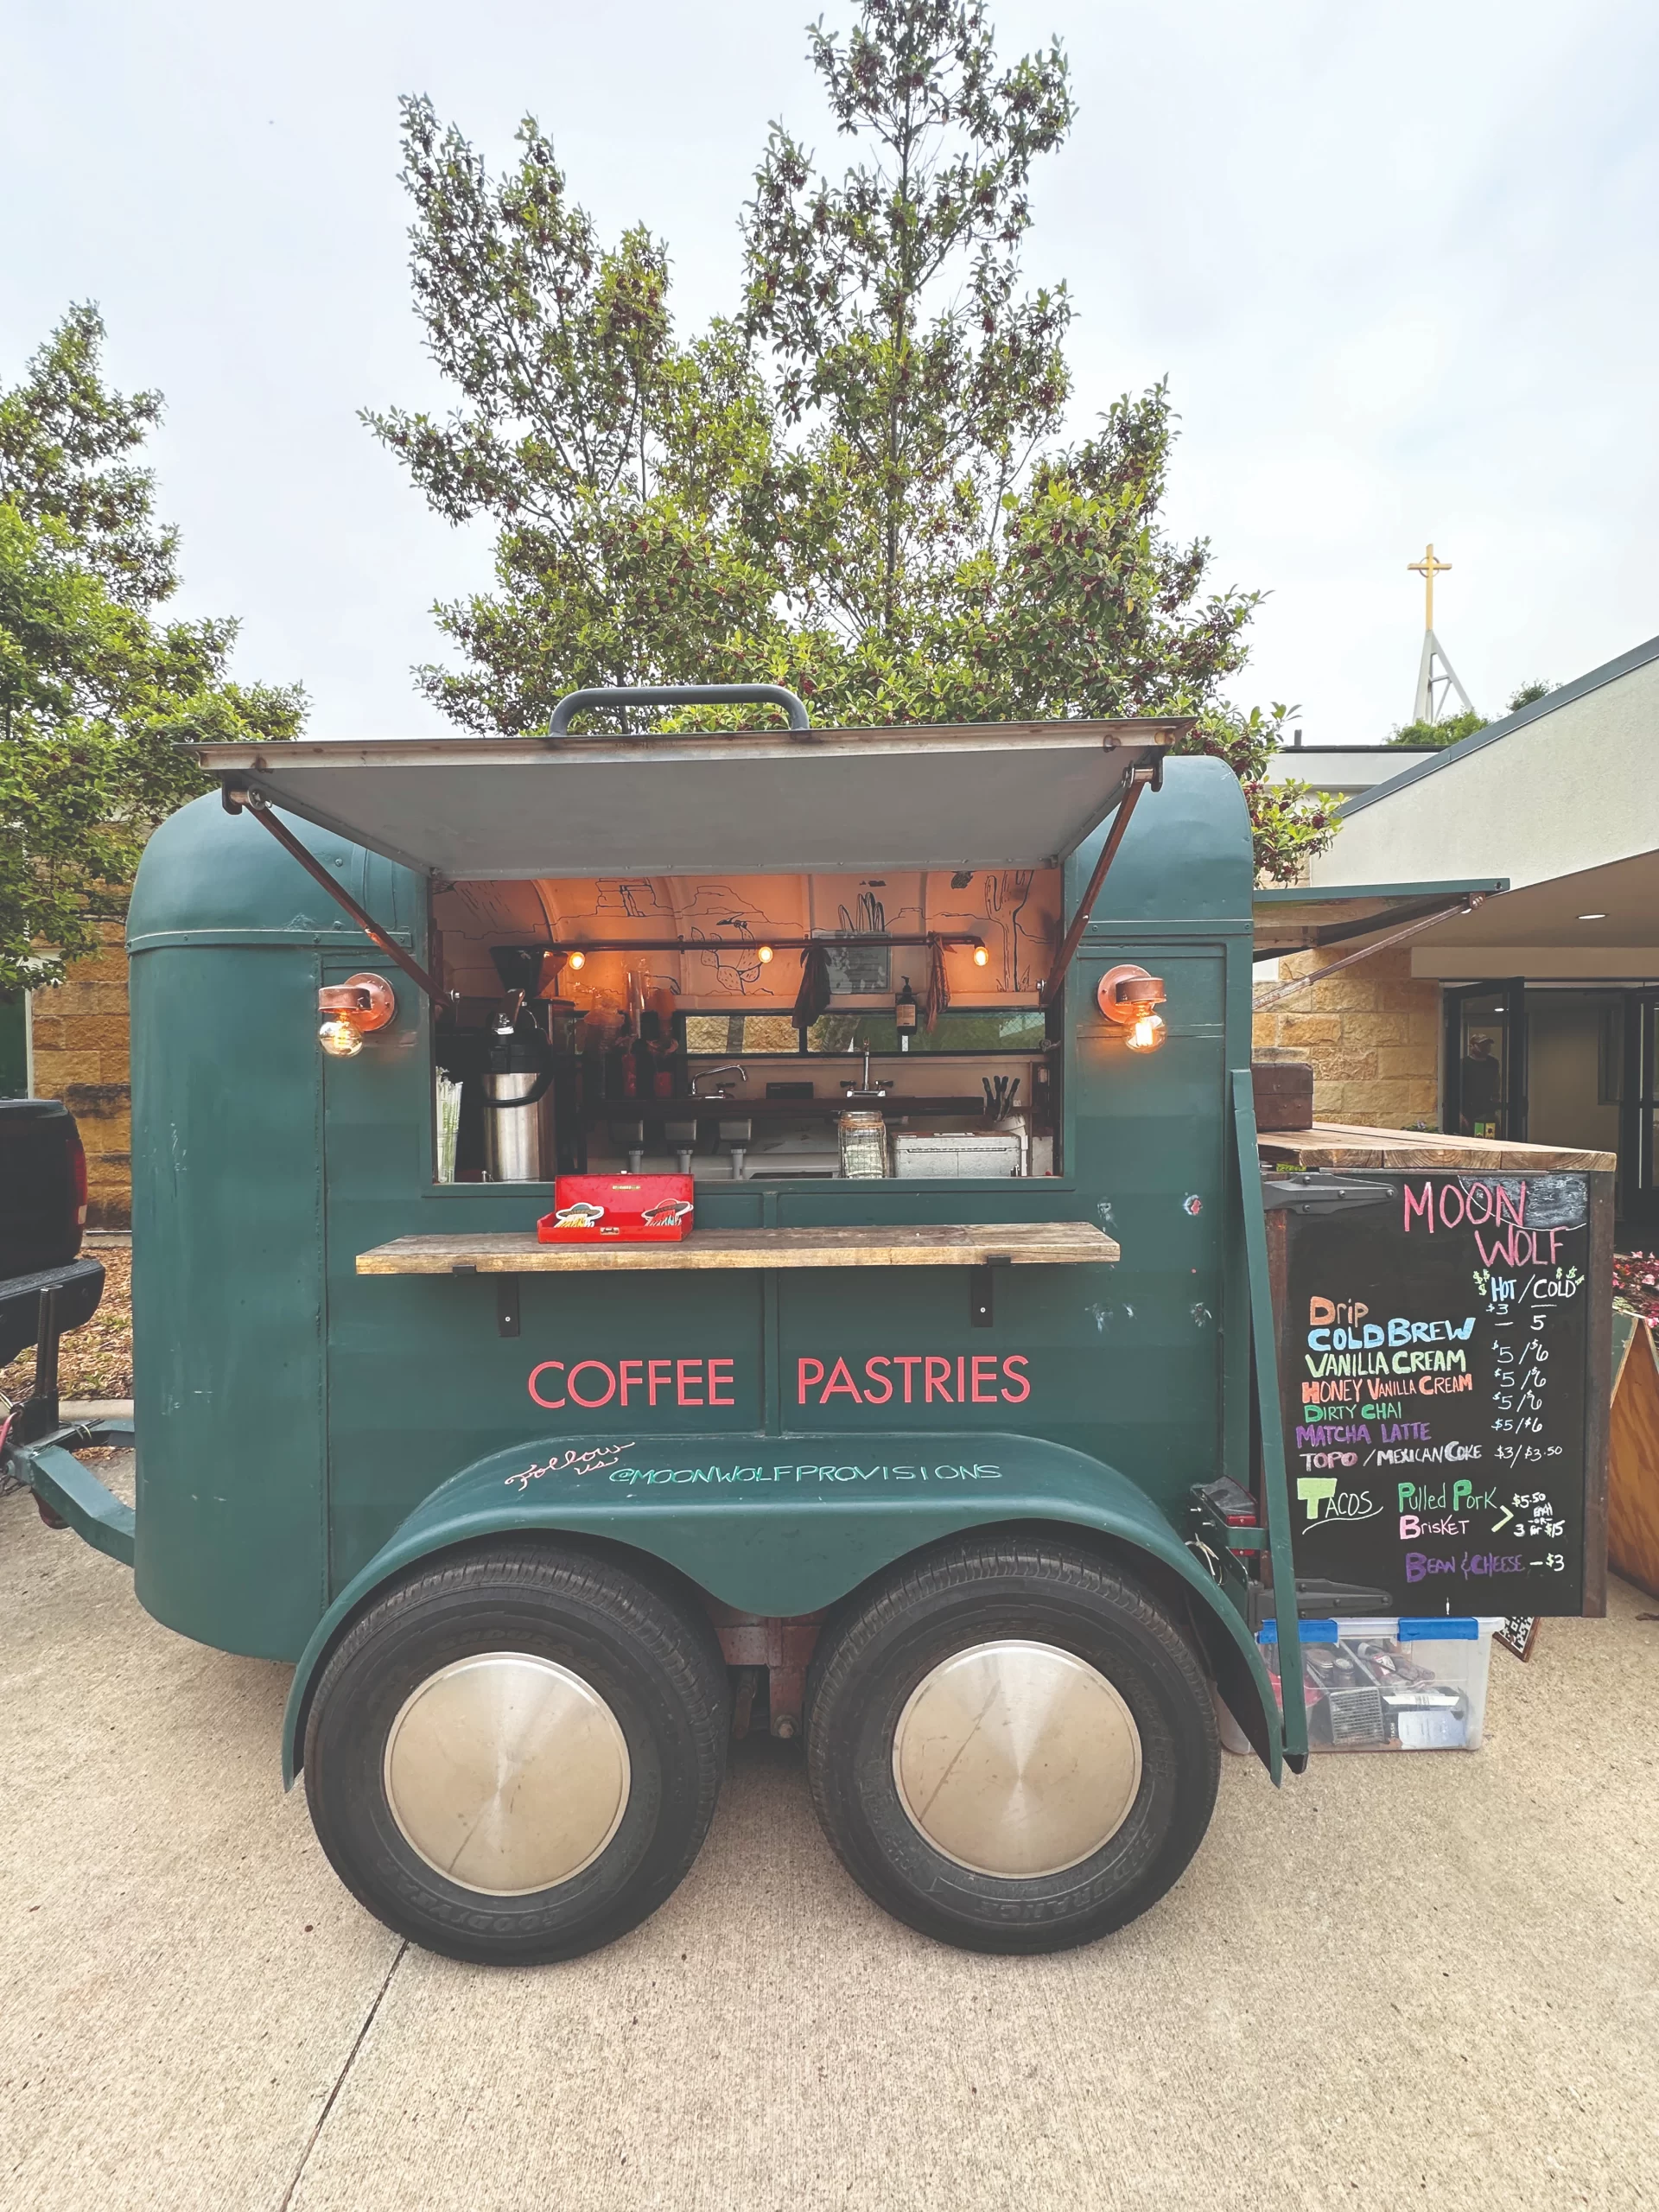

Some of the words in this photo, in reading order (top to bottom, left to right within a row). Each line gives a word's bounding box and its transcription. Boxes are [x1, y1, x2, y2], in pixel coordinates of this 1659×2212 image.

[1403, 1180, 1526, 1233] MOON
[1474, 1225, 1567, 1268] WOLF
[1310, 1296, 1369, 1327] Drip
[1486, 1303, 1509, 1315] $3
[1305, 1351, 1390, 1377] VANILLA
[1391, 1349, 1466, 1375] CREAM
[528, 1357, 735, 1408] COFFEE
[798, 1355, 1032, 1405] PASTRIES
[1301, 1378, 1363, 1403] HONEY
[1367, 1378, 1417, 1401] VANILLA
[1418, 1373, 1473, 1395] CREAM
[1304, 1404, 1357, 1423] DIRTY
[1361, 1401, 1402, 1420] CHAI
[1295, 1424, 1372, 1449] MATCHA
[1381, 1422, 1432, 1444] LATTE
[1300, 1452, 1358, 1471] TOPO
[1297, 1478, 1373, 1519] TACOS
[1398, 1482, 1446, 1512] Pulled
[1513, 1523, 1526, 1537] 3
[1406, 1553, 1456, 1583] BEAN
[1470, 1553, 1525, 1577] CHEESE
